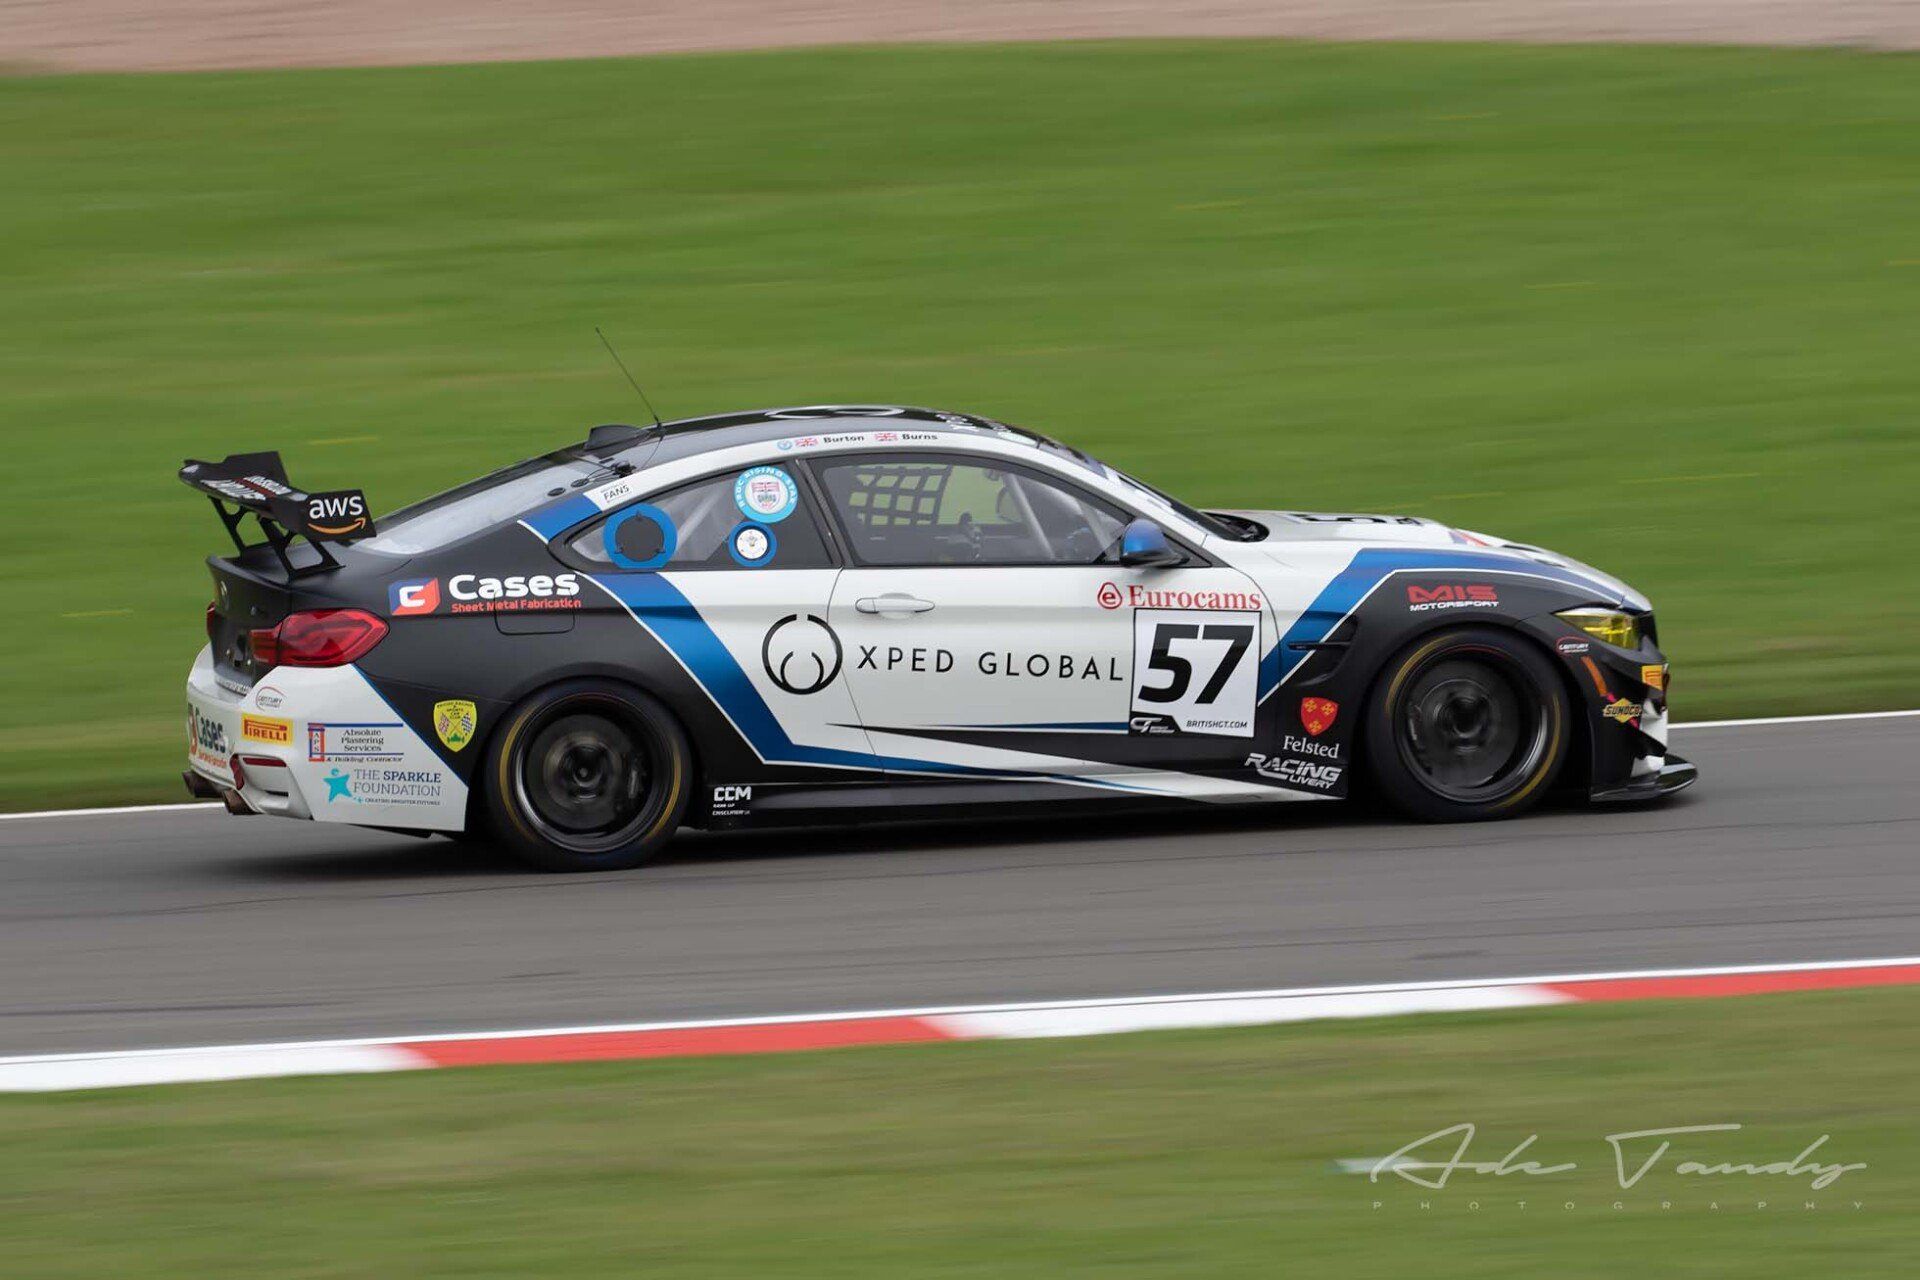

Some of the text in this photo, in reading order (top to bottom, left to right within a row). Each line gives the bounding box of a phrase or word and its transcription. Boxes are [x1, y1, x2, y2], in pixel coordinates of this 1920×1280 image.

[823, 434, 865, 443] Burton
[901, 433, 938, 441] Burns
[603, 484, 630, 500] FANS
[308, 495, 364, 519] aws
[448, 573, 580, 600] Cases
[1407, 585, 1498, 602] MIS
[1127, 585, 1262, 610] Eurocams
[451, 598, 581, 613] Sheet Metal Fabrication
[1409, 600, 1499, 612] MOTORSPORT
[977, 652, 1124, 681] GLOBAL
[1137, 623, 1255, 705] 57
[1603, 704, 1643, 717] SUNOCO
[243, 718, 288, 741] PIRELLI
[1186, 720, 1248, 728] BRITISHGT.COM
[343, 728, 382, 736] Absolute
[341, 736, 384, 744] Plastering
[1283, 735, 1340, 759] Felsted
[344, 744, 382, 752] Services
[1244, 752, 1342, 782] RACING
[353, 768, 442, 783] THE SPARKLE
[1289, 774, 1335, 789] LIVERY
[354, 781, 441, 797] FOUNDATION
[713, 786, 752, 801] CCM
